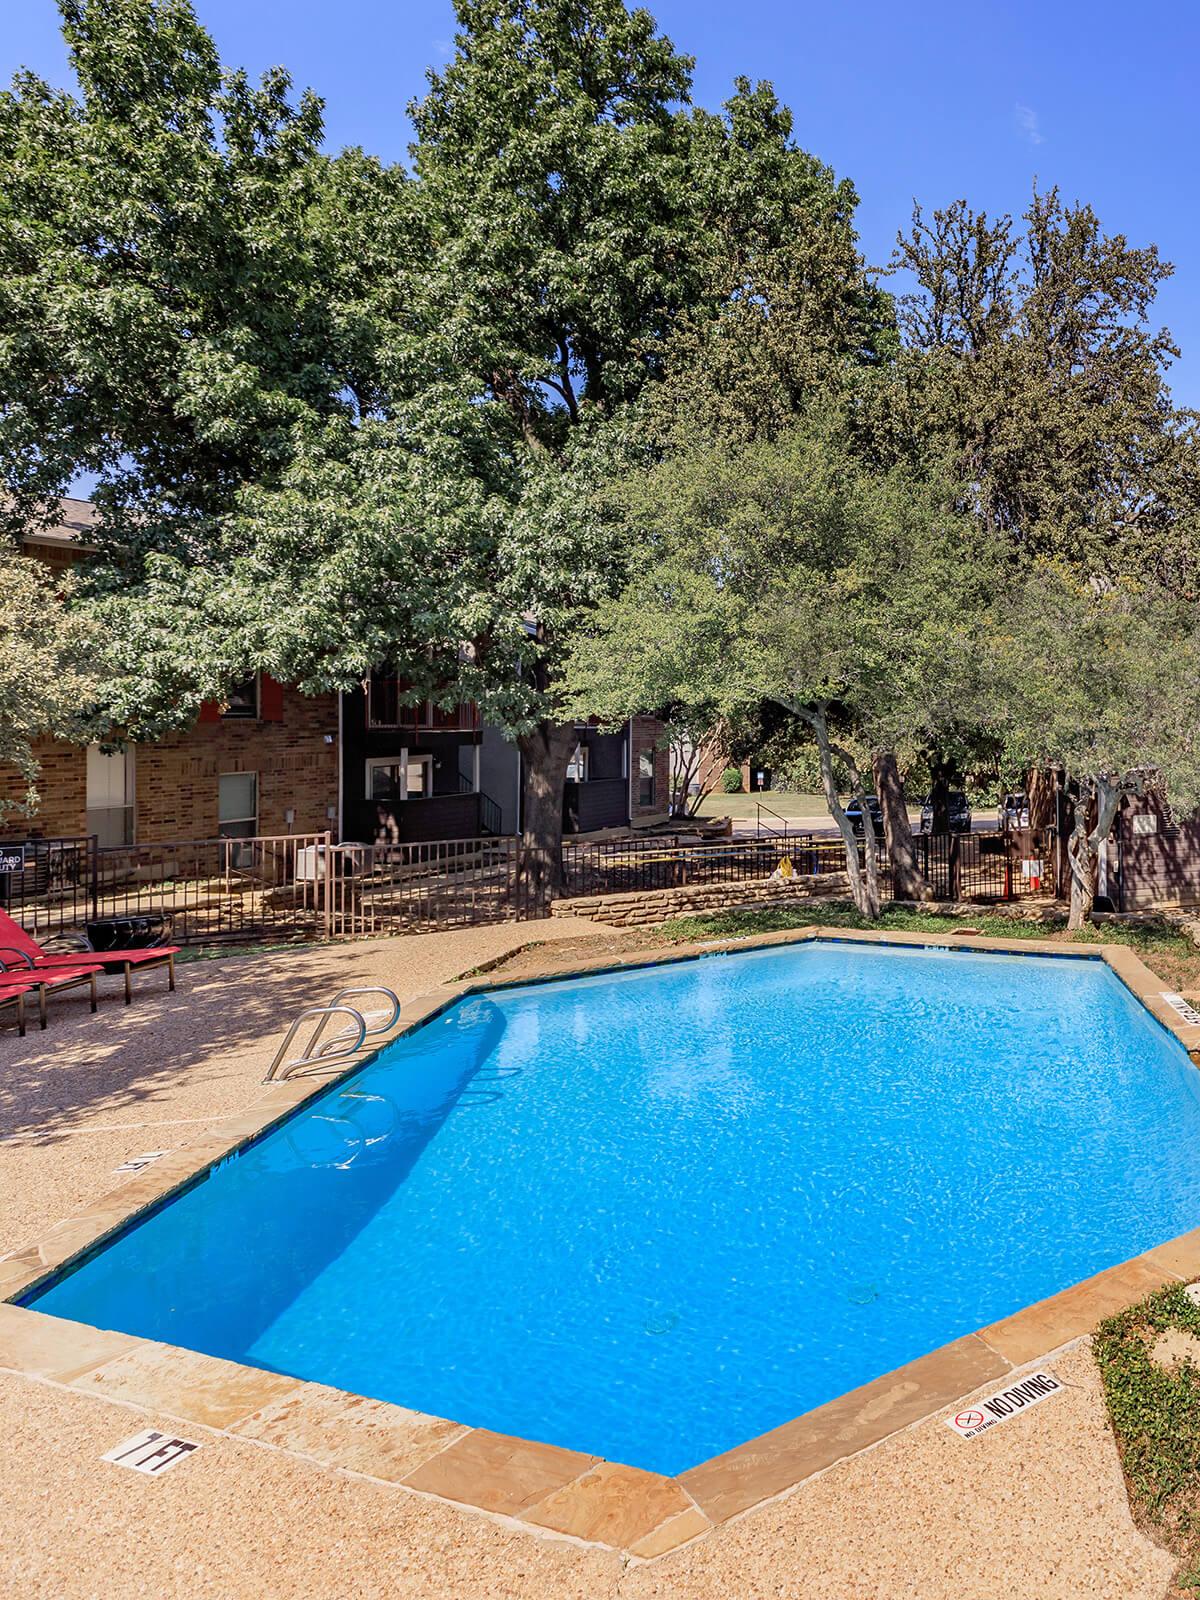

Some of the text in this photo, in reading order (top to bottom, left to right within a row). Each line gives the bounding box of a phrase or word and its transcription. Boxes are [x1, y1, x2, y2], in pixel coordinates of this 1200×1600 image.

[984, 1374, 1060, 1418] NO DIVING
[964, 1418, 998, 1439] NO DIVING
